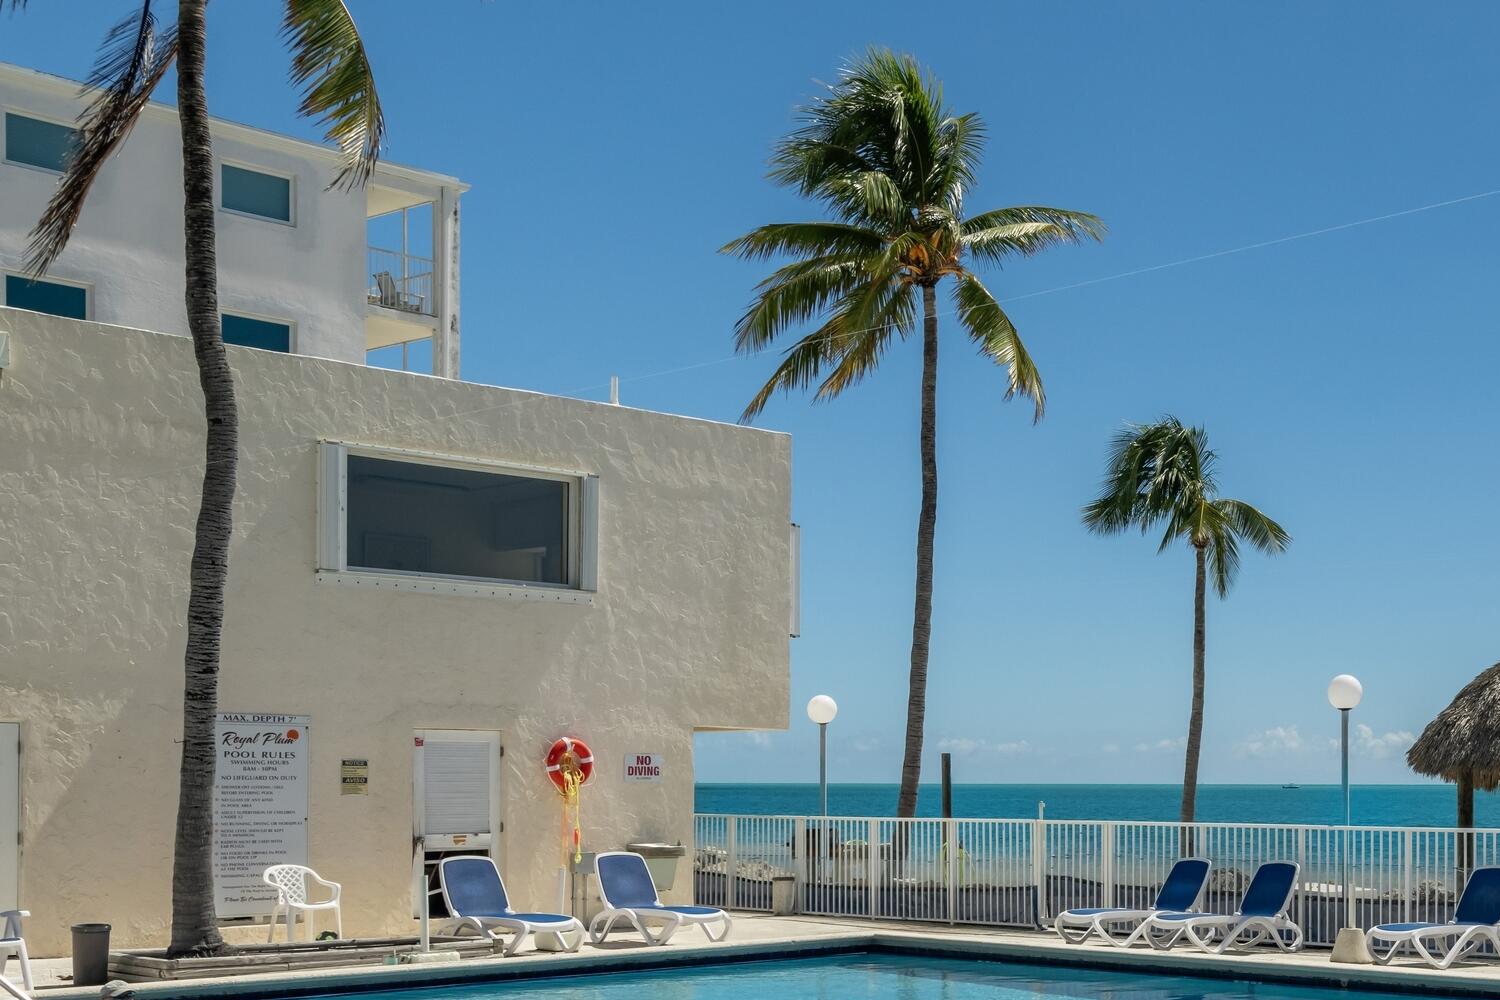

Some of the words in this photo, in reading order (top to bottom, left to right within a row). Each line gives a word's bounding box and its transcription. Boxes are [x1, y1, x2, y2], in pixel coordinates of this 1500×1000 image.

[252, 715, 285, 723] DEPTH
[222, 731, 260, 749] Royal
[262, 732, 294, 746] Plum
[223, 750, 256, 758] POOL
[262, 751, 296, 759] RULES
[636, 755, 651, 766] NO
[627, 766, 660, 776] DIVING
